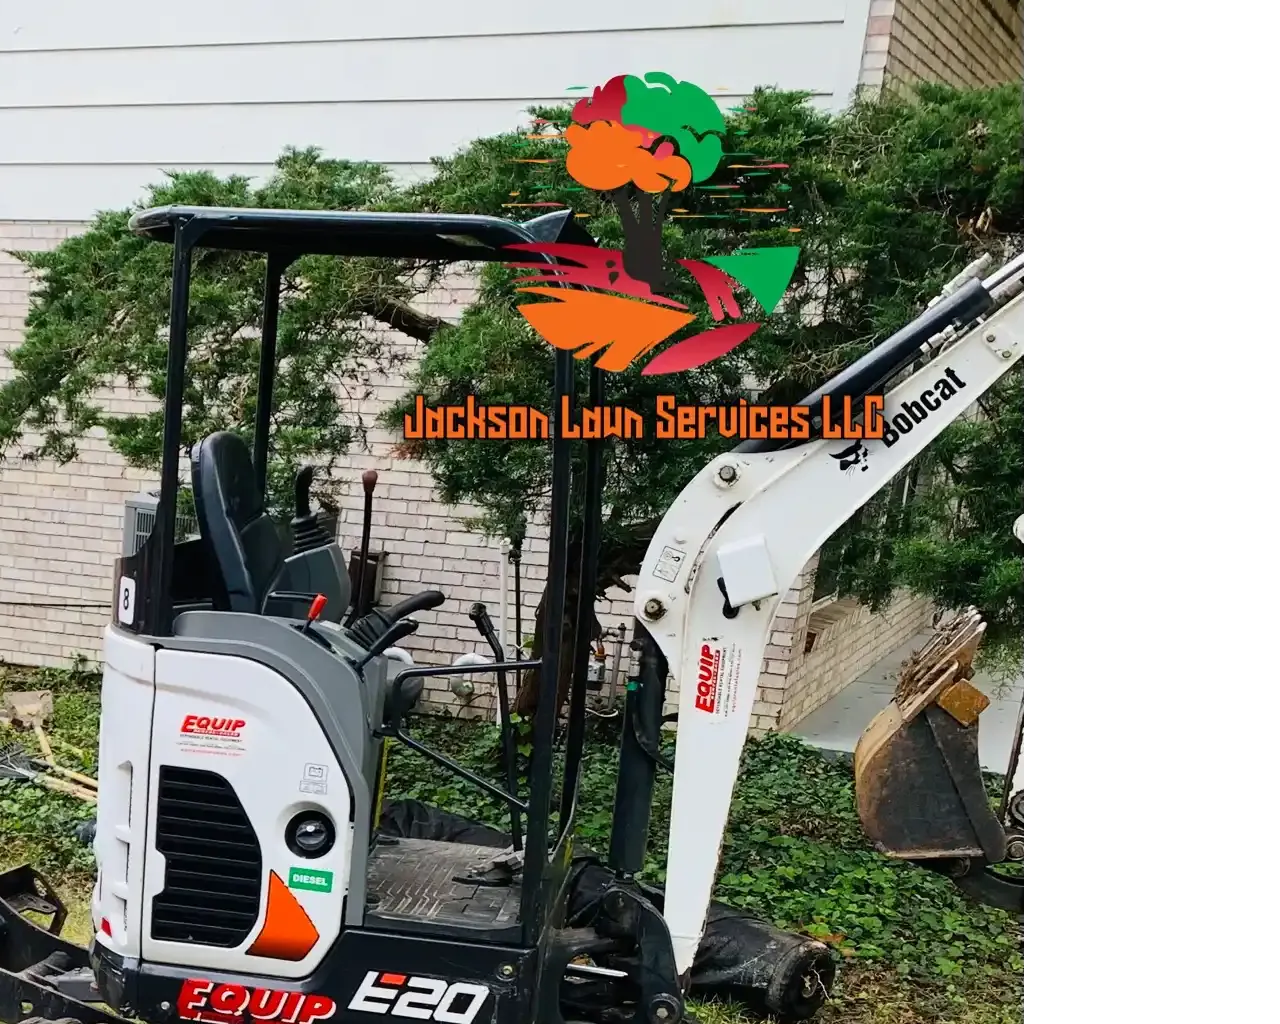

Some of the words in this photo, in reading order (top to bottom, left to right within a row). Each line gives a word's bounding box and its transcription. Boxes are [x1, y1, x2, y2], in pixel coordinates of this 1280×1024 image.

[882, 366, 967, 448] Bobcat
[123, 587, 130, 611] 8
[695, 644, 714, 714] EQUIP
[181, 715, 246, 732] EQUIP
[292, 873, 328, 887] DIESEL
